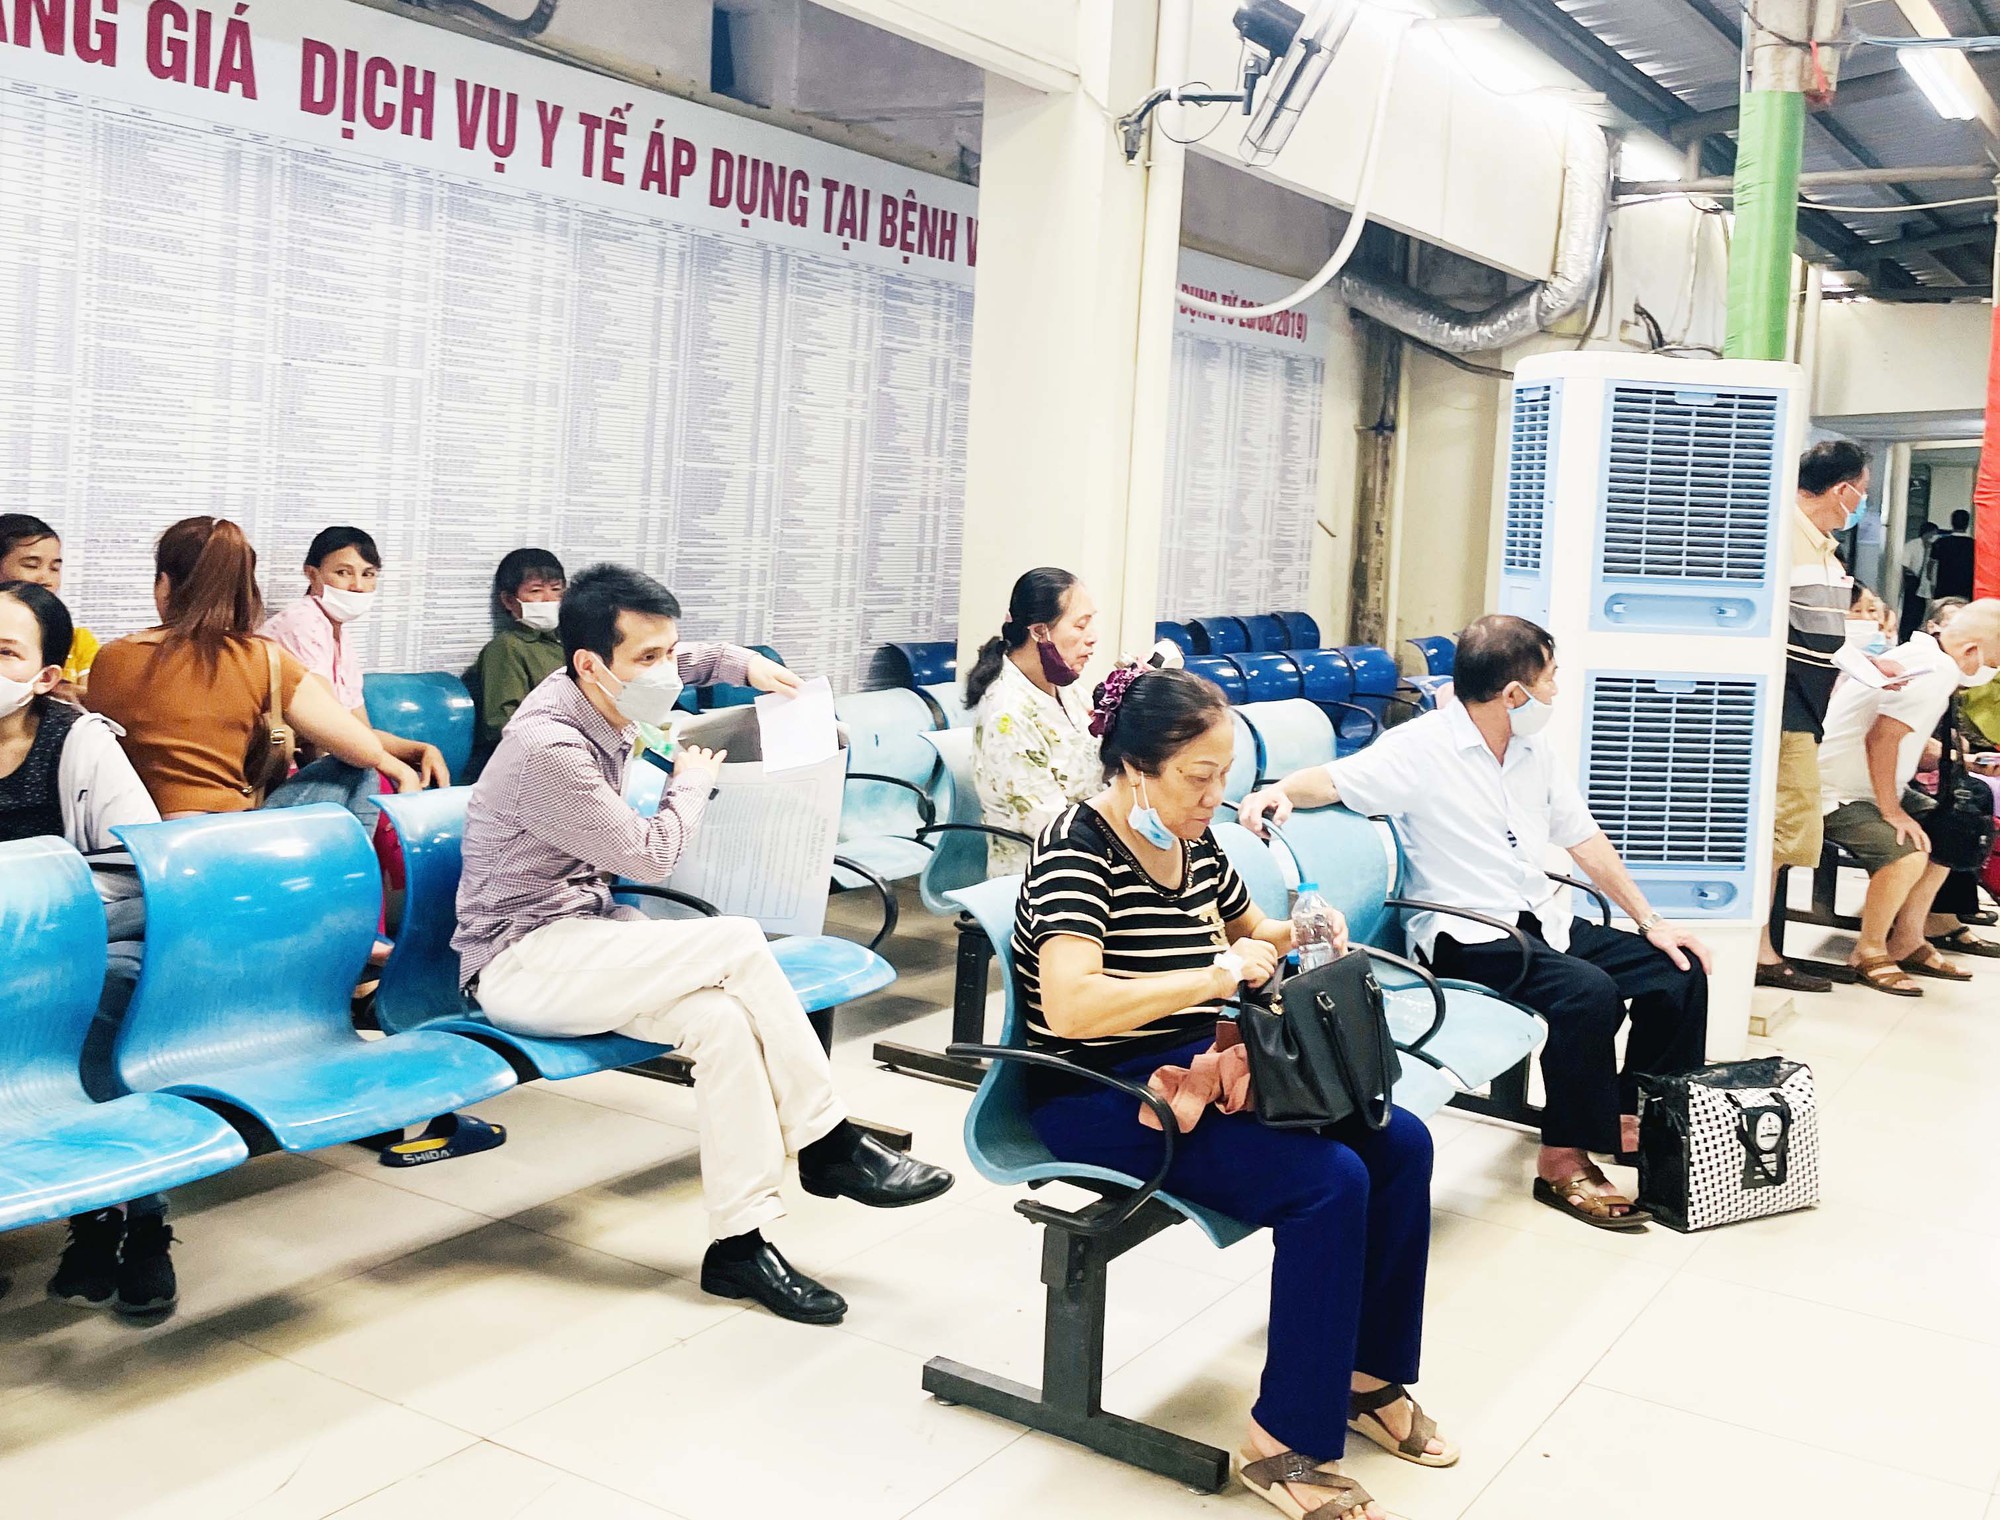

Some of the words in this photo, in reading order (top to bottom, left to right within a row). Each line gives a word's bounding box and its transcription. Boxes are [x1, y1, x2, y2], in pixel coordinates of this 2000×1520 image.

[0, 0, 118, 67] NG
[146, 0, 258, 100] GIÁ
[300, 38, 437, 141] DỊCH
[455, 78, 519, 173] VỤ
[535, 99, 564, 168] Y
[578, 102, 634, 186] TẾ
[640, 119, 697, 198] ÁP
[709, 147, 810, 228] DỤNG
[820, 177, 870, 251] TẠI
[879, 188, 958, 264] BỆNH
